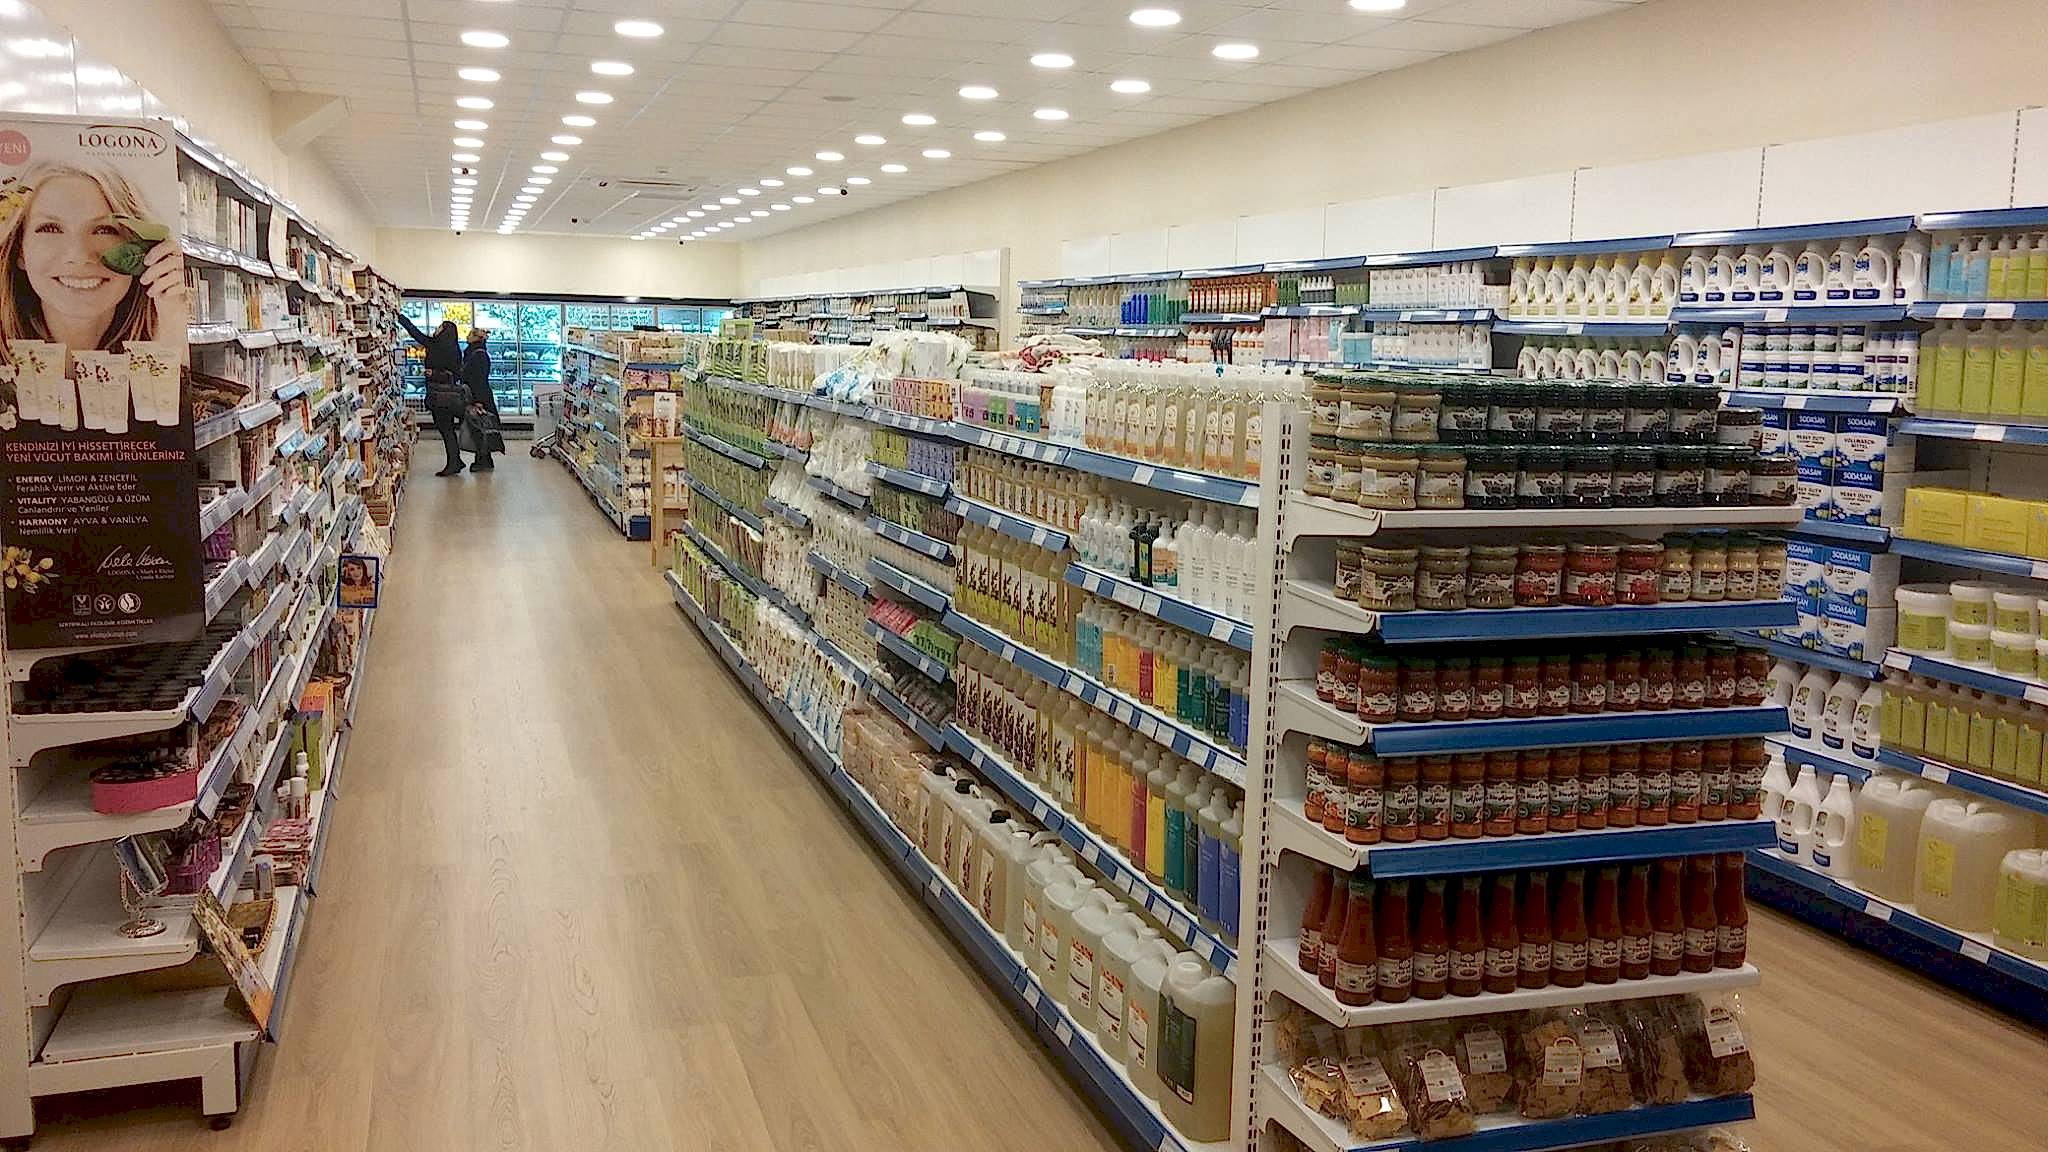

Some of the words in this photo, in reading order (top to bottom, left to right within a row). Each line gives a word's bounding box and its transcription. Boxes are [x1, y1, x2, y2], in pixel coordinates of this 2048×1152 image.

[78, 133, 158, 149] LOGONA
[1799, 415, 1826, 425] SODASAN
[1847, 417, 1876, 427] SODASAN
[5, 440, 58, 452] KENDİNİZİ
[61, 440, 75, 451] İYİ
[78, 440, 157, 451] HİSSETTİRECEK
[6, 452, 31, 463] YENİ
[33, 451, 71, 462] VÜCUT
[74, 452, 113, 462] BAKIMI
[116, 450, 185, 461] ÜRÜNLERİNİZ
[1798, 467, 1822, 476] ODASAN
[1843, 471, 1872, 482] SODASAN
[15, 475, 53, 484] ENERGY
[17, 497, 57, 505] VITALITY
[18, 518, 68, 527] HARMONY
[73, 517, 100, 525] AYVA
[1831, 550, 1861, 562] SODASAN
[1827, 603, 1857, 616] SODASAN
